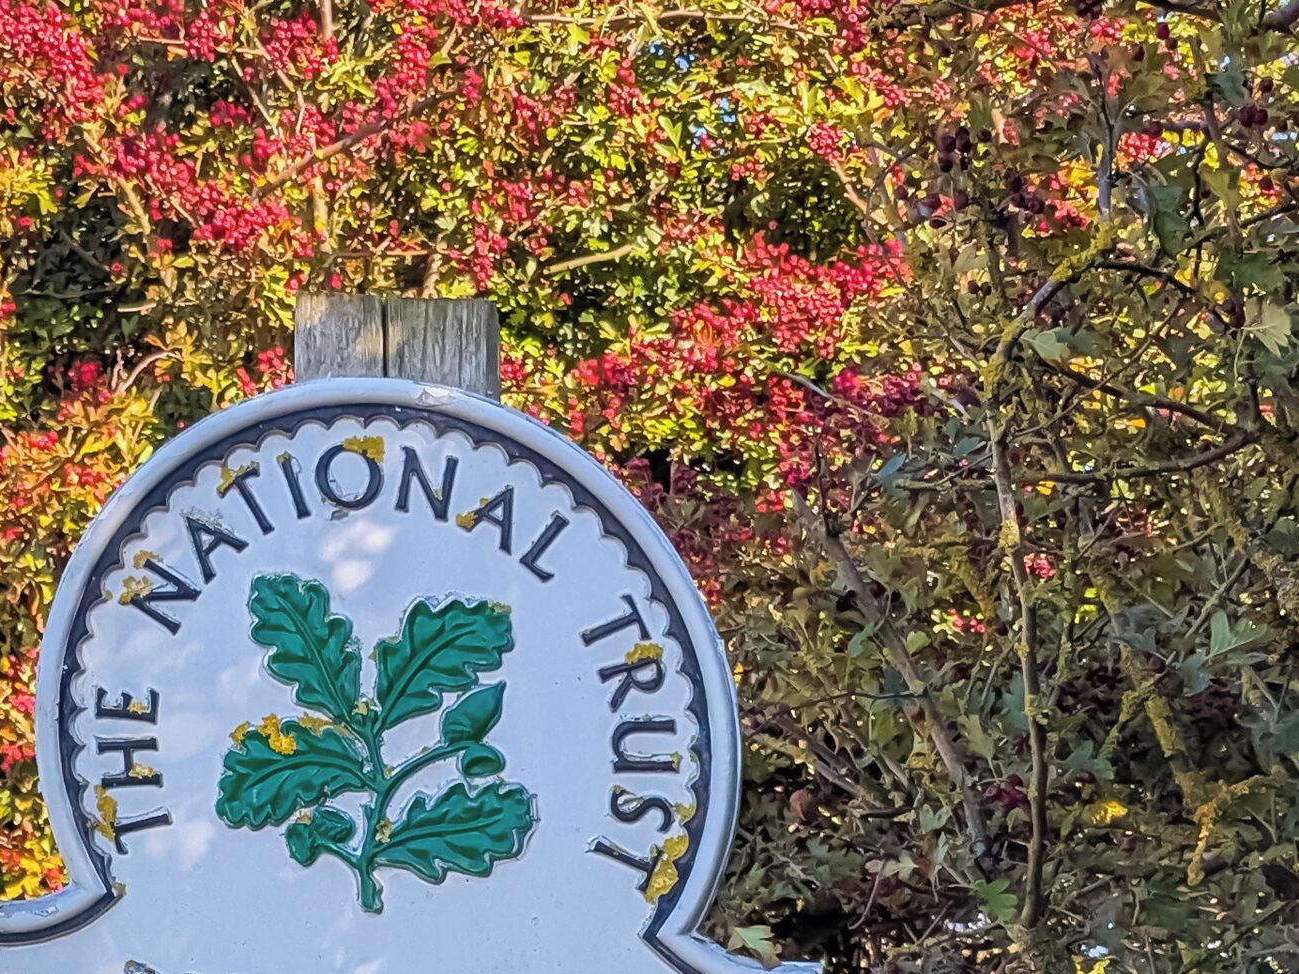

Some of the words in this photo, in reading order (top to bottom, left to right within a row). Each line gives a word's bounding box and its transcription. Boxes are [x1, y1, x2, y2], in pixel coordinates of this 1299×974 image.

[127, 443, 569, 635] NATIONAL
[95, 687, 171, 853] THE
[581, 595, 679, 893] TRUST
